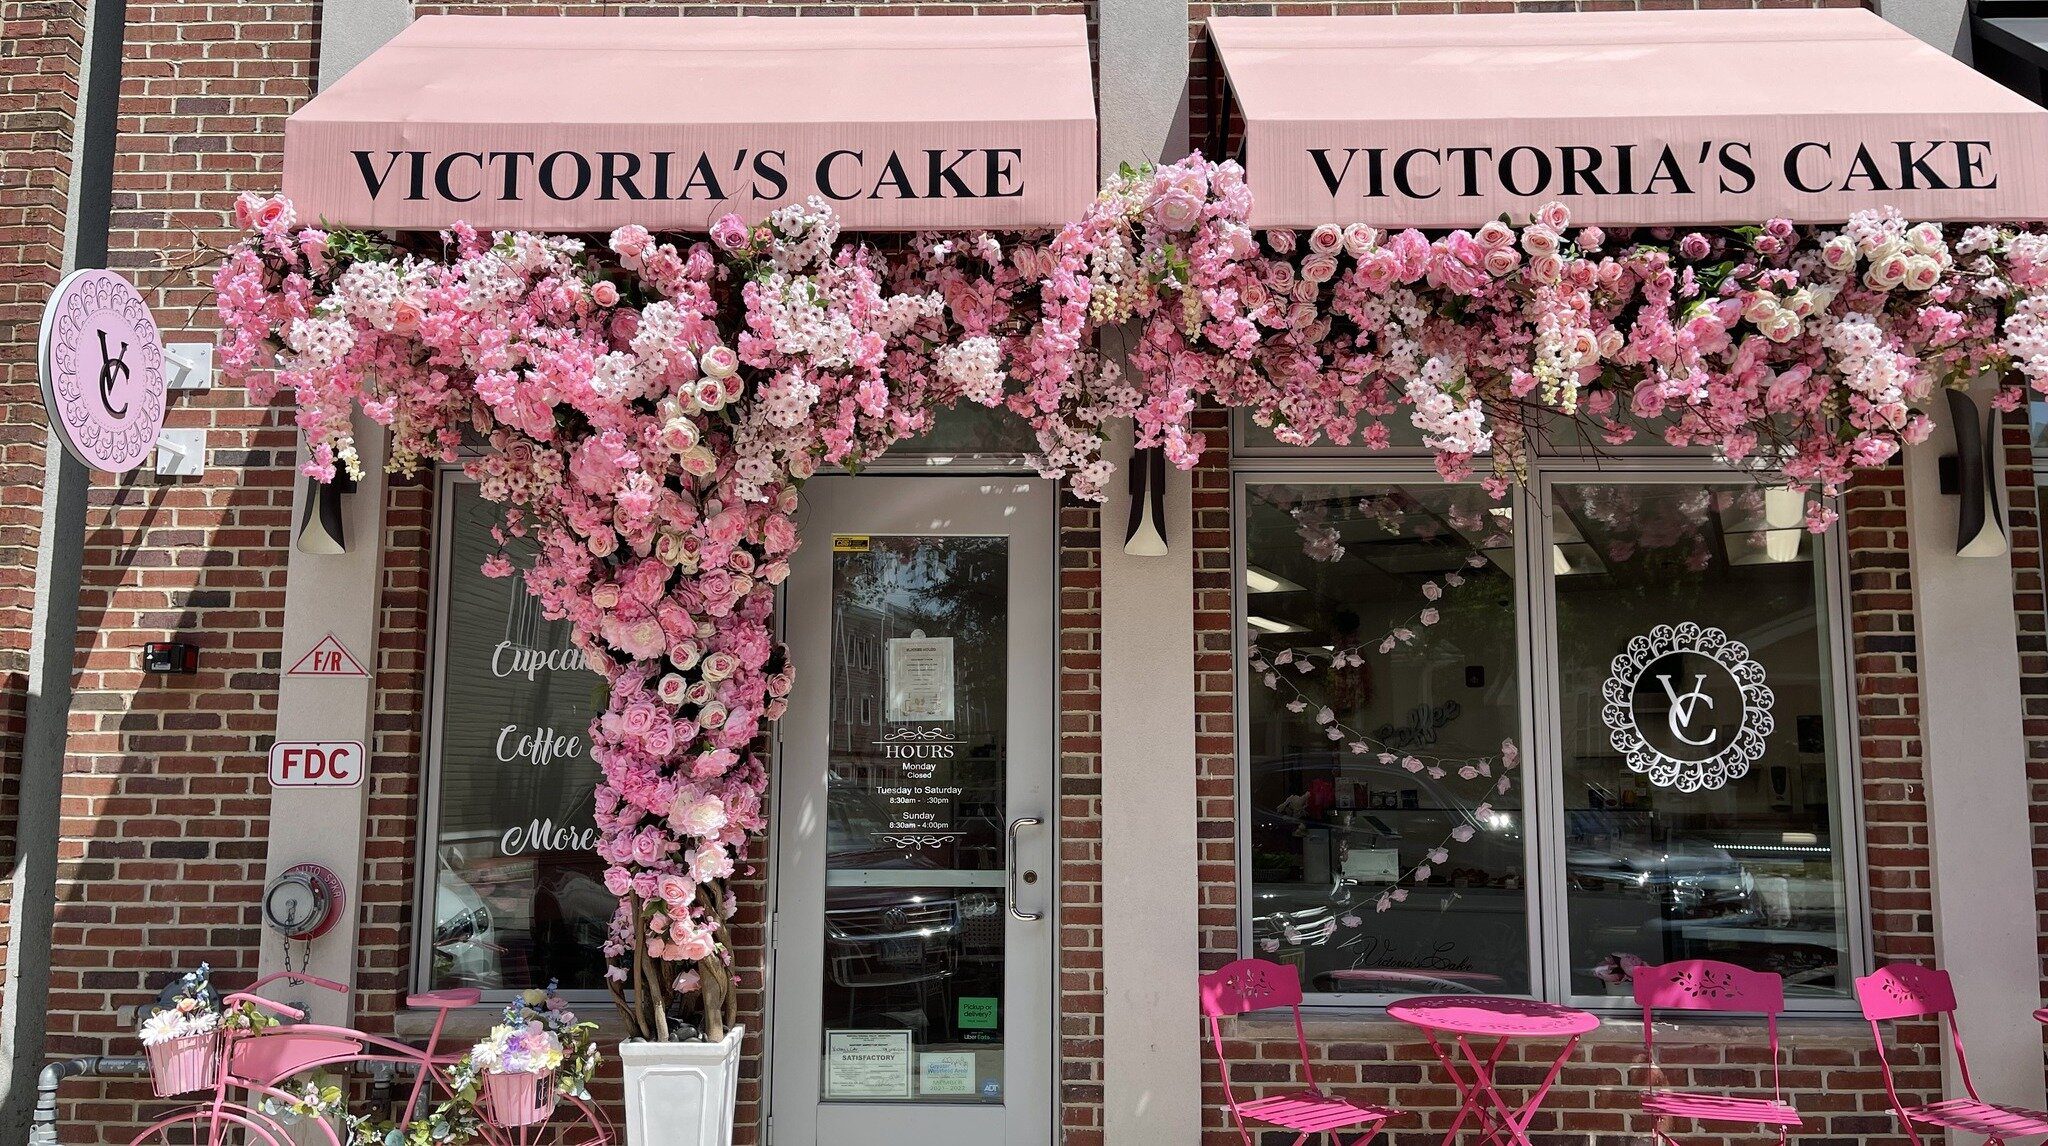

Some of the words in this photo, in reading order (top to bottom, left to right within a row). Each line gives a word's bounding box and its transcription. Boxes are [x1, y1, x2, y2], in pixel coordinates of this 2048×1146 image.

[350, 148, 788, 202] VICTORIA'S
[815, 148, 1025, 201] CAKE
[1306, 141, 1756, 199] VICTORIA'S
[1783, 141, 1998, 193] CAKE
[313, 651, 342, 671] F/R
[496, 724, 583, 765] Coffee
[885, 744, 954, 759] HOURS
[282, 748, 350, 779] FDC
[902, 762, 937, 772] Monday
[876, 786, 913, 796] Tuesday
[924, 786, 963, 796] Saturday
[889, 796, 916, 804] 8:30am
[902, 811, 935, 821] Sunday
[889, 821, 916, 829] 8:30am
[921, 821, 949, 830] 4:00pm
[500, 818, 597, 856] More
[963, 1003, 984, 1012] Pickup
[983, 1084, 999, 1092] ADT
